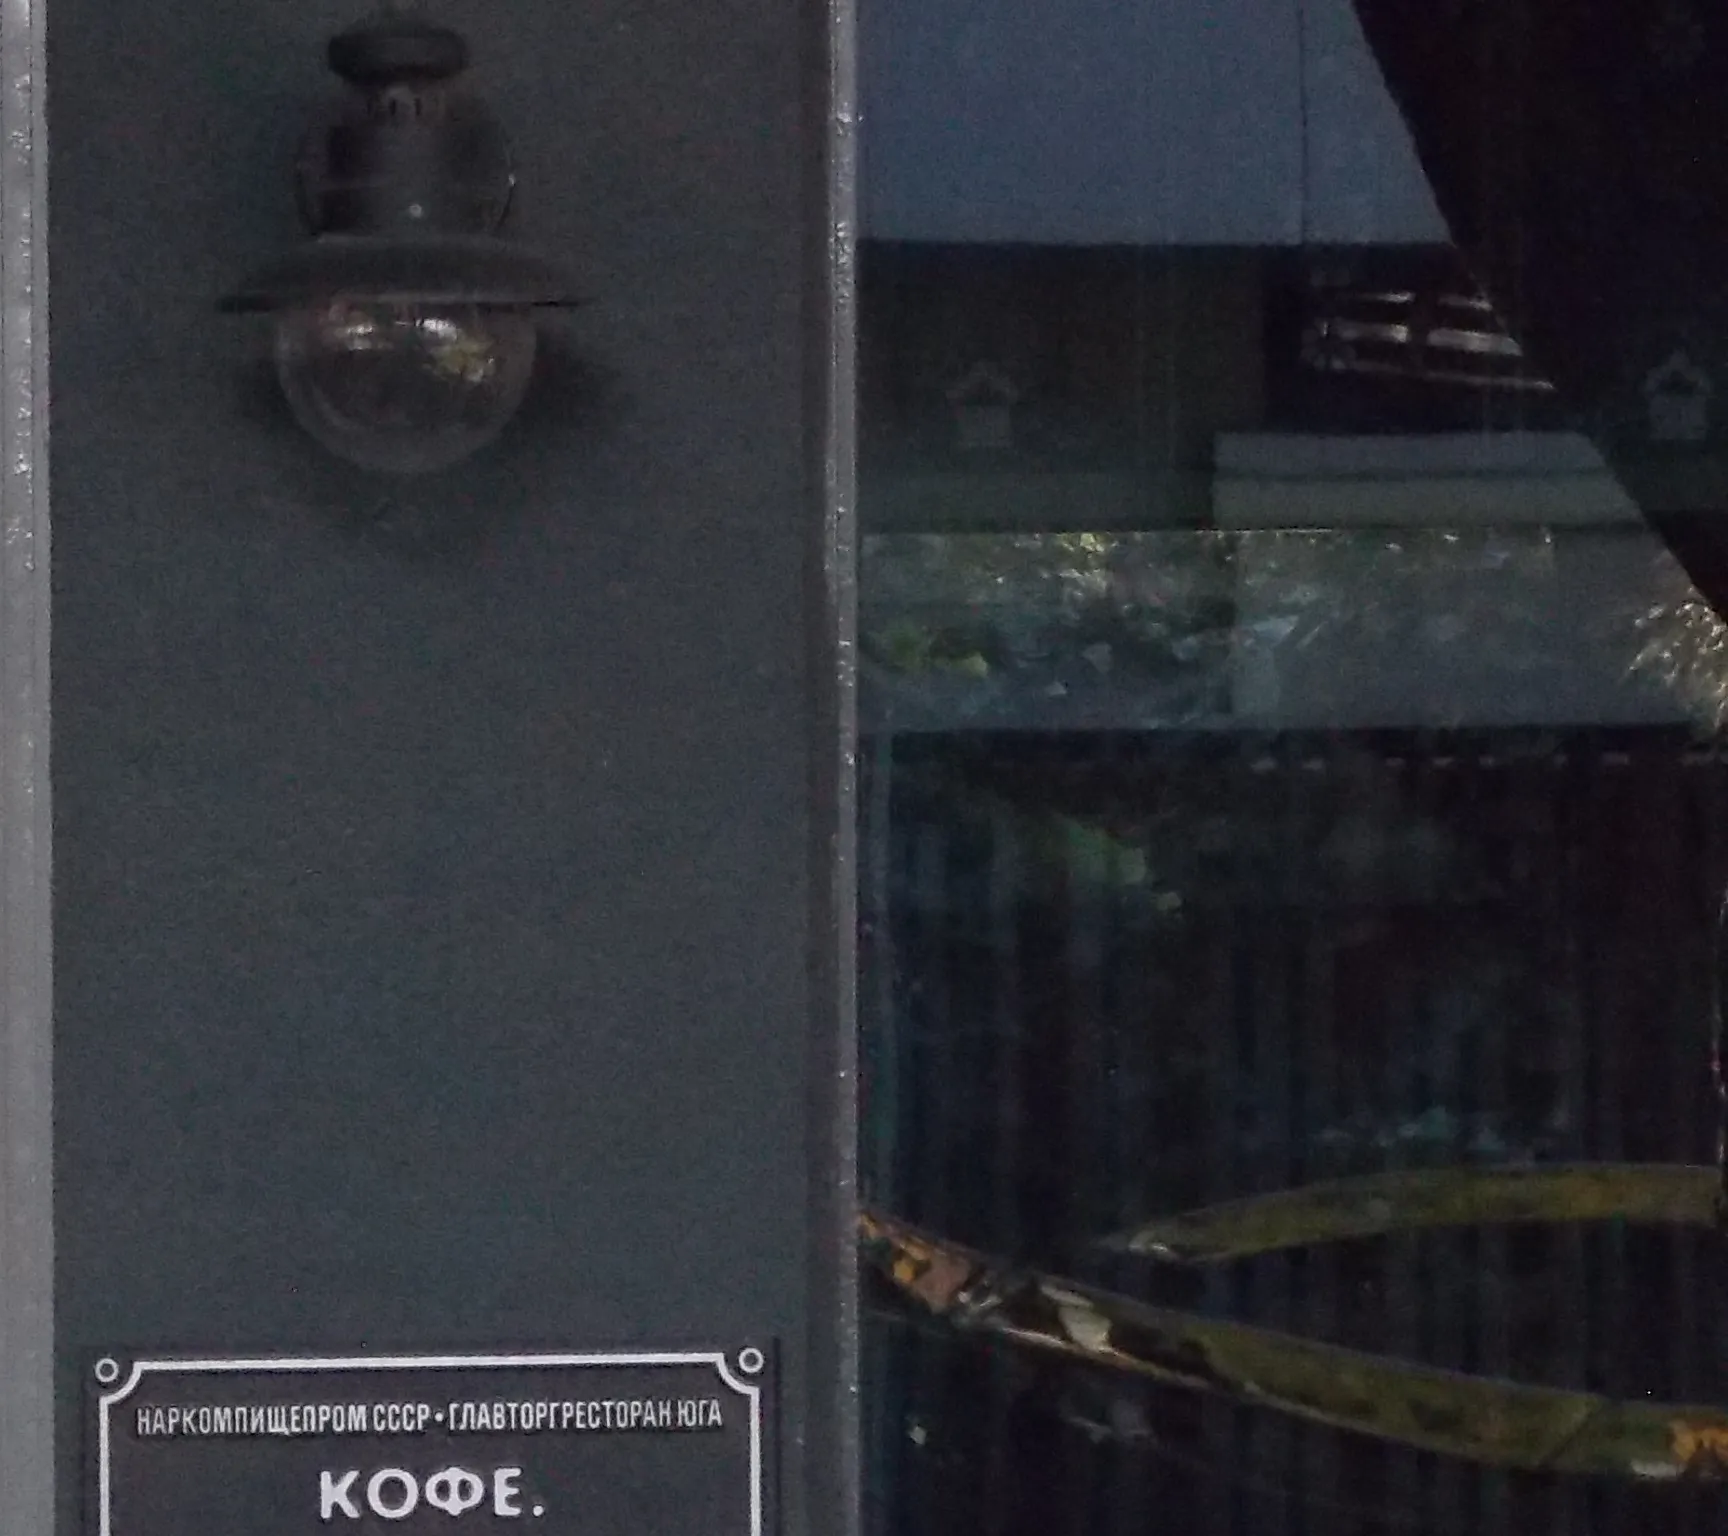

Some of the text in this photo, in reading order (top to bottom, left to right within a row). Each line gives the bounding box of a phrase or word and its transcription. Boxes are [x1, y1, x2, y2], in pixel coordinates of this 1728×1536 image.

[136, 1399, 722, 1437] НАРКОМПИЩЕПРОМ СССР ГЛАВТОРГРЕСТОРАН ЮГА
[319, 1465, 546, 1521] КОФЕ.
